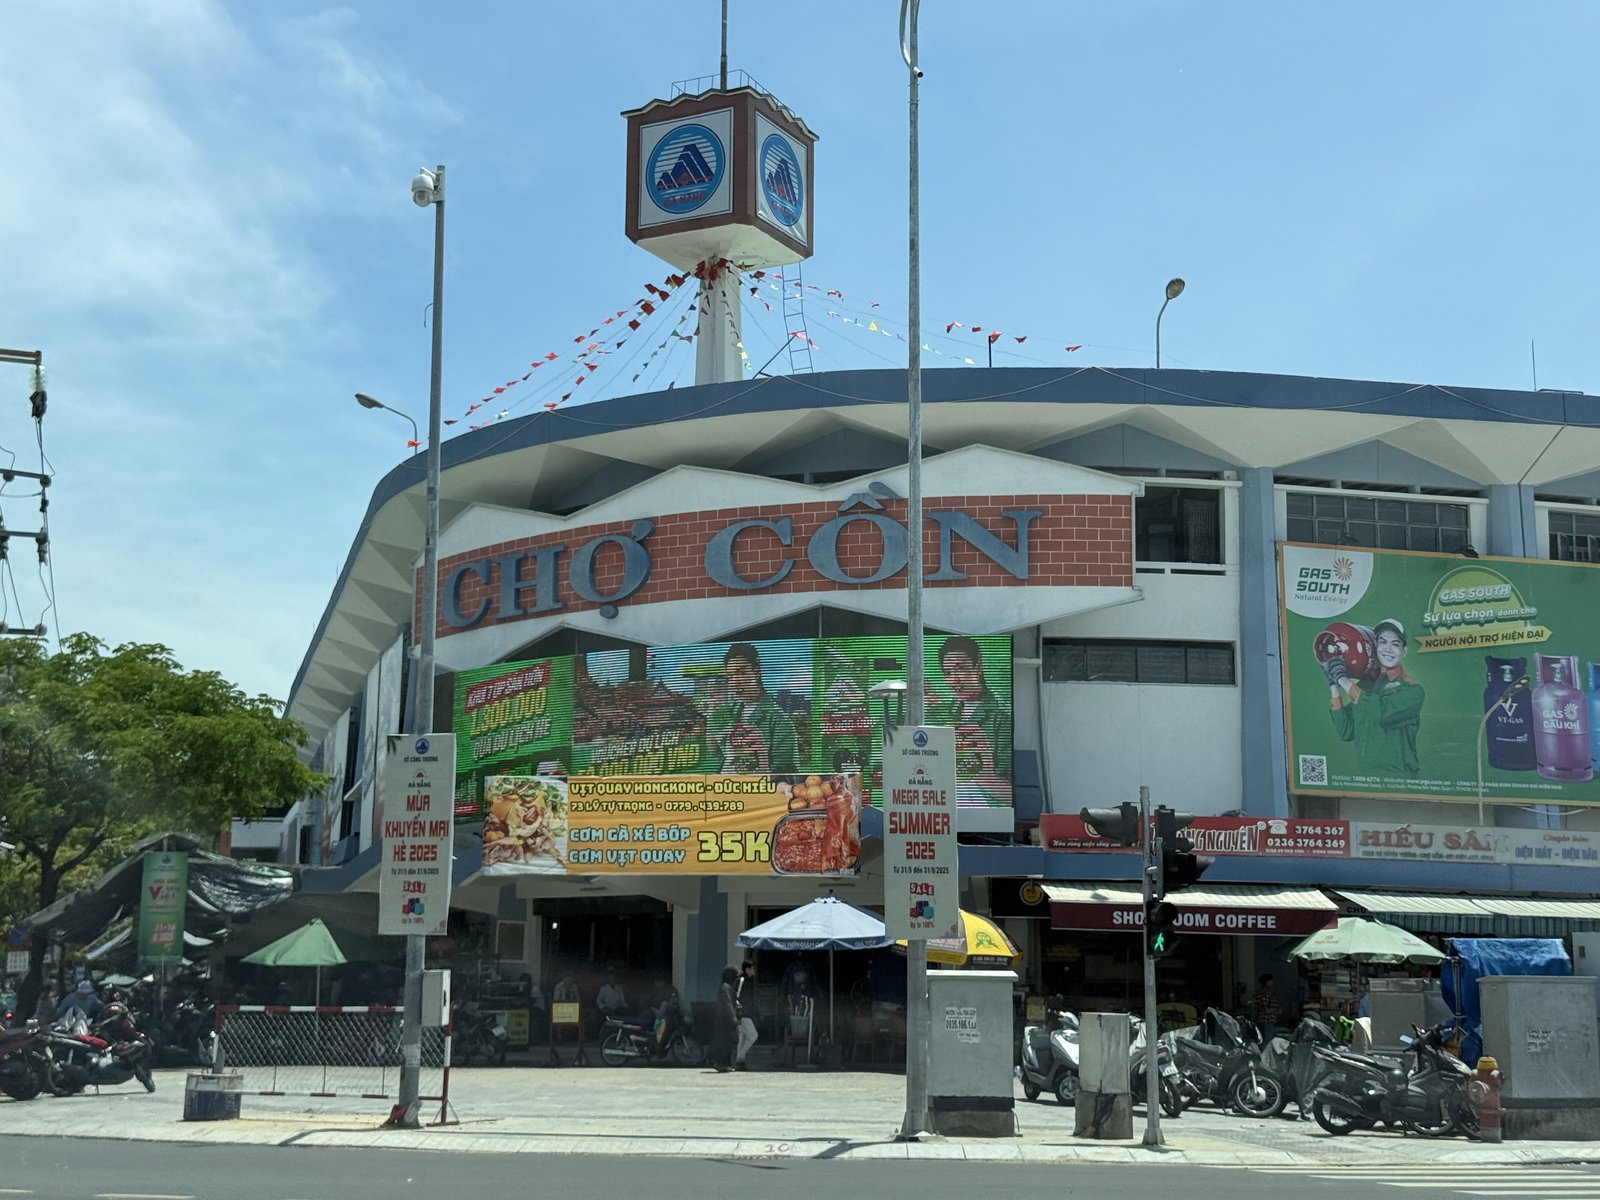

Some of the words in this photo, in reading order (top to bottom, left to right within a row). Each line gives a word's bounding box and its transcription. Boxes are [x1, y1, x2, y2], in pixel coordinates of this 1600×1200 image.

[441, 519, 656, 628] CHỢ
[704, 481, 1043, 590] CỒN
[1299, 567, 1332, 579] GAS
[1296, 580, 1350, 595] SOUTH
[1440, 588, 1467, 601] GAS
[1468, 584, 1510, 599] SOUTH
[1294, 593, 1322, 601] Natural
[1324, 596, 1348, 604] Energy
[1425, 636, 1456, 648] NGƯỜI
[1459, 633, 1477, 646] NỘI
[1480, 632, 1499, 644] TRỢ
[1501, 630, 1524, 642] HIỆN
[1527, 628, 1544, 640] ĐẠI
[1497, 716, 1524, 724] VT-GAS
[1542, 710, 1563, 719] GAS
[571, 782, 595, 797] VỊT
[597, 782, 631, 795] QUAY
[634, 782, 705, 794] HONGKONG
[714, 780, 741, 795] ĐỨC
[742, 776, 777, 794] HIẾU
[406, 791, 430, 812] MÙA
[571, 801, 584, 811] 73
[617, 800, 653, 813] TRỌNG
[892, 789, 919, 806] MEGA
[922, 789, 947, 806] SALE
[385, 813, 426, 838] KHUYẾN
[429, 819, 449, 842] MẠI
[889, 812, 951, 835] SUMMER
[1295, 826, 1322, 835] 3764
[1324, 827, 1344, 836] 367
[570, 826, 604, 842] CƠM
[607, 824, 629, 842] GÀ
[632, 824, 654, 842] XÉ
[658, 824, 691, 842] BÓP
[1206, 825, 1260, 852] NGUYÊN
[1359, 823, 1435, 849] HIẾU
[393, 840, 406, 862] HÈ
[410, 844, 437, 861] 2025
[697, 831, 771, 862] 35K
[906, 841, 936, 859] 2025
[1267, 838, 1295, 847] 0236
[1296, 838, 1323, 848] 3764
[1325, 839, 1345, 848] 369
[569, 848, 603, 864] CƠM
[607, 848, 638, 867] VỊT
[640, 848, 686, 864] QUAY
[404, 882, 425, 893] SALE
[910, 883, 933, 895] SALE
[1112, 911, 1209, 928] SHOOOM
[1215, 914, 1276, 929] COFFEE
